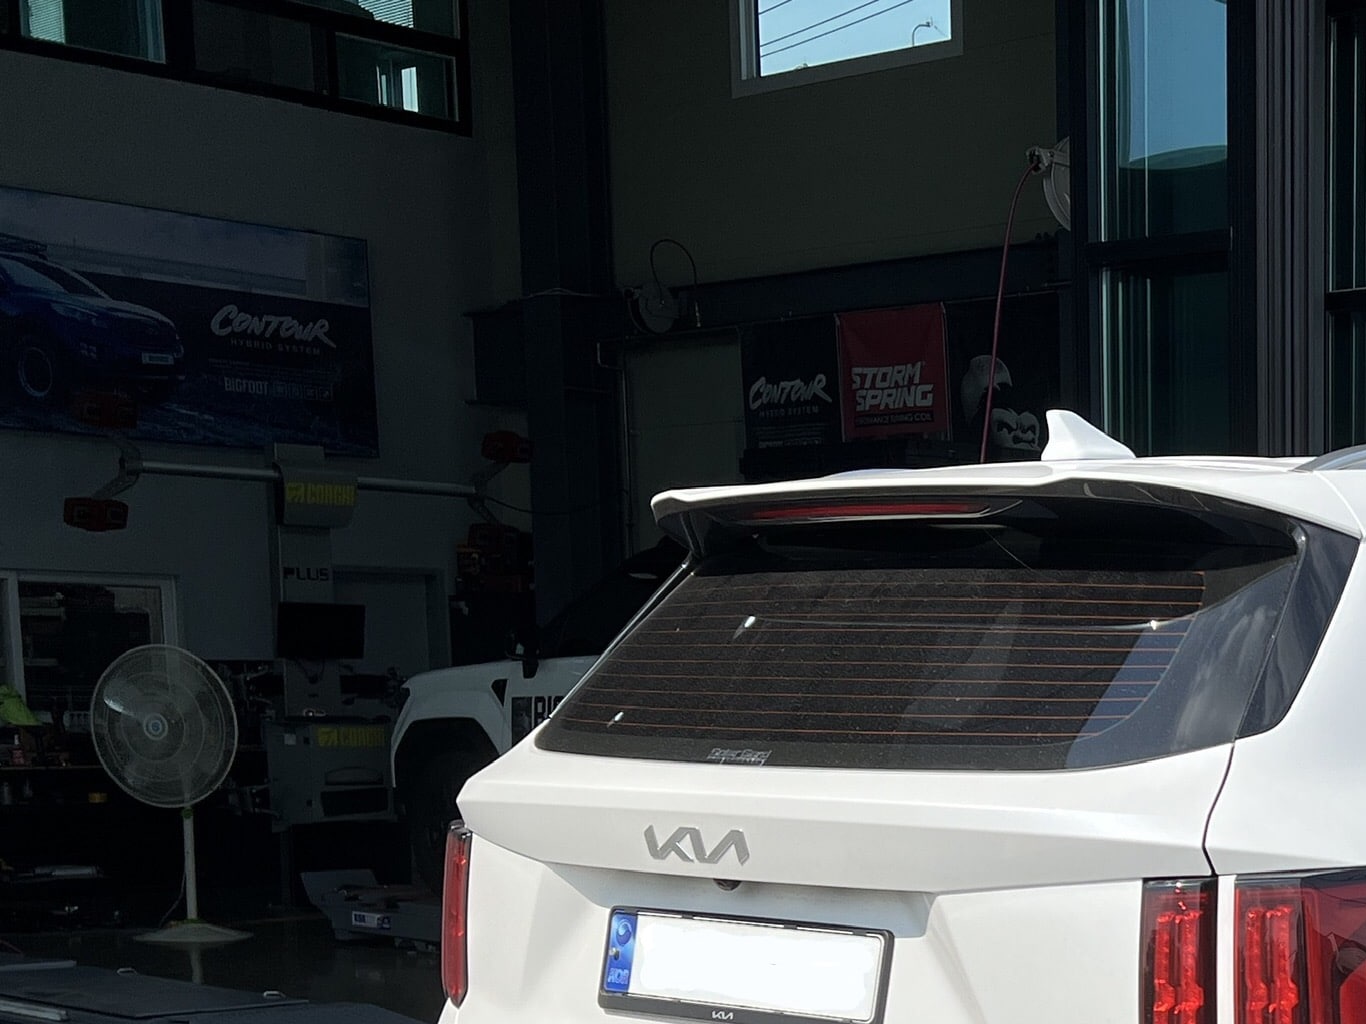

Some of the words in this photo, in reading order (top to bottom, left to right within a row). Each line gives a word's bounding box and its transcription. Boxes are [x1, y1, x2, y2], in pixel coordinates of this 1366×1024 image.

[210, 304, 337, 348] CONTOUR
[224, 376, 270, 396] BIGFOOT
[851, 361, 922, 390] STORM
[749, 373, 833, 411] CONTOUR
[856, 384, 935, 412] SPRING
[283, 566, 329, 581] PLUS
[643, 824, 750, 866] KIA
[711, 1010, 734, 1020] KIA
